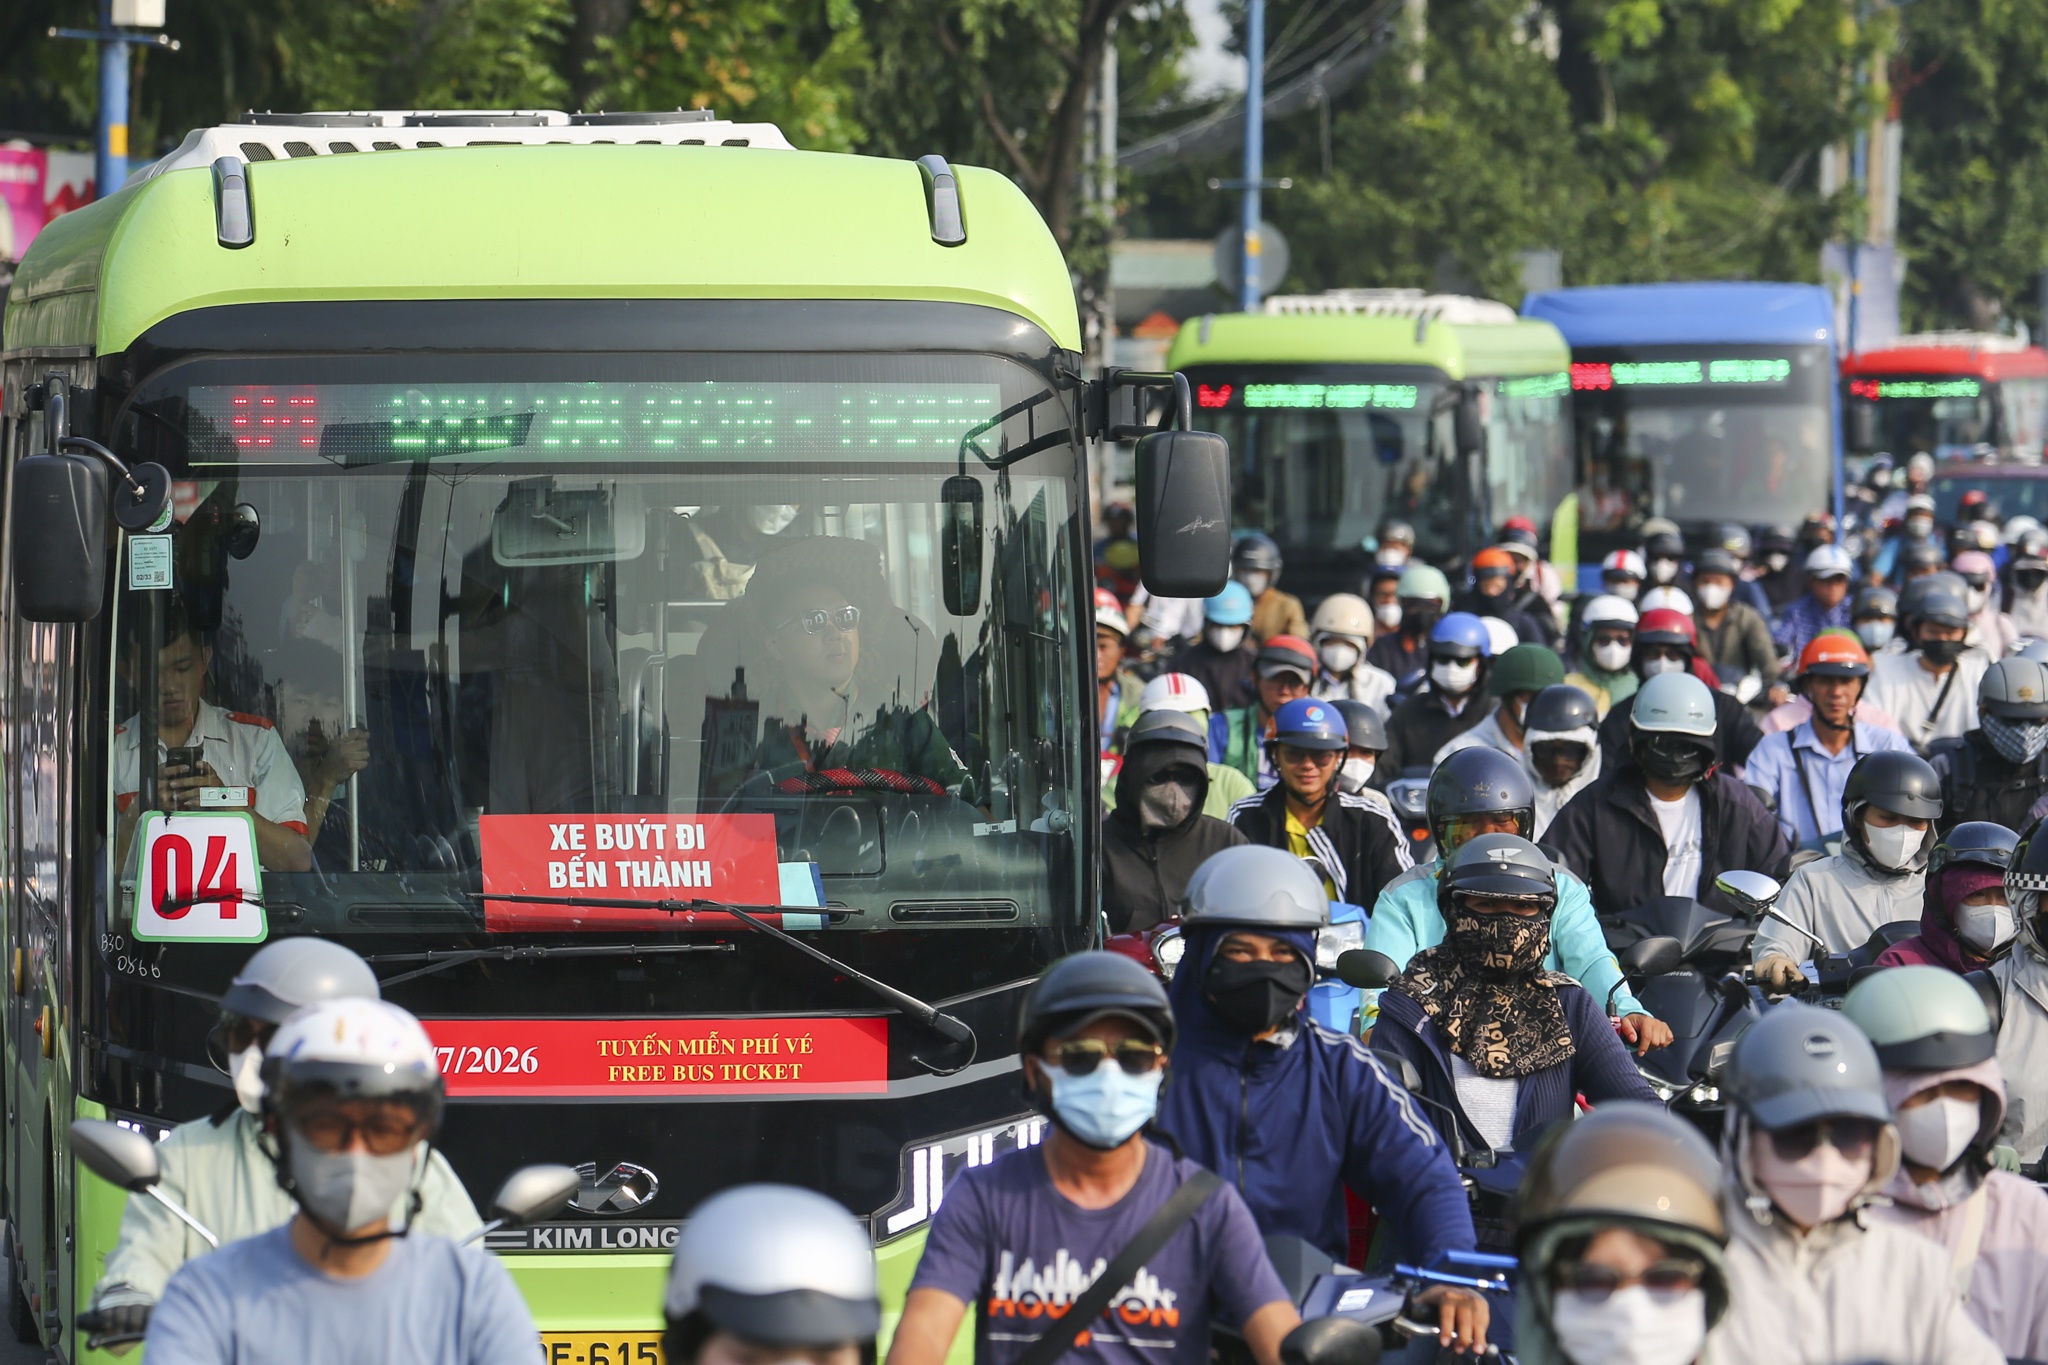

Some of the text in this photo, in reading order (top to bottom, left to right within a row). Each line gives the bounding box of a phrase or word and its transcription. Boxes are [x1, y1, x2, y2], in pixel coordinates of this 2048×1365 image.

[549, 818, 706, 851] XE BUÝT ĐI
[151, 833, 243, 920] 04
[548, 853, 713, 889] BẾN THÀNH
[597, 1030, 814, 1057] TUYẾN MIỄN PHÍ VÉ
[608, 1063, 803, 1082] FREE BUS TICKET
[533, 1227, 681, 1248] KIM LONG
